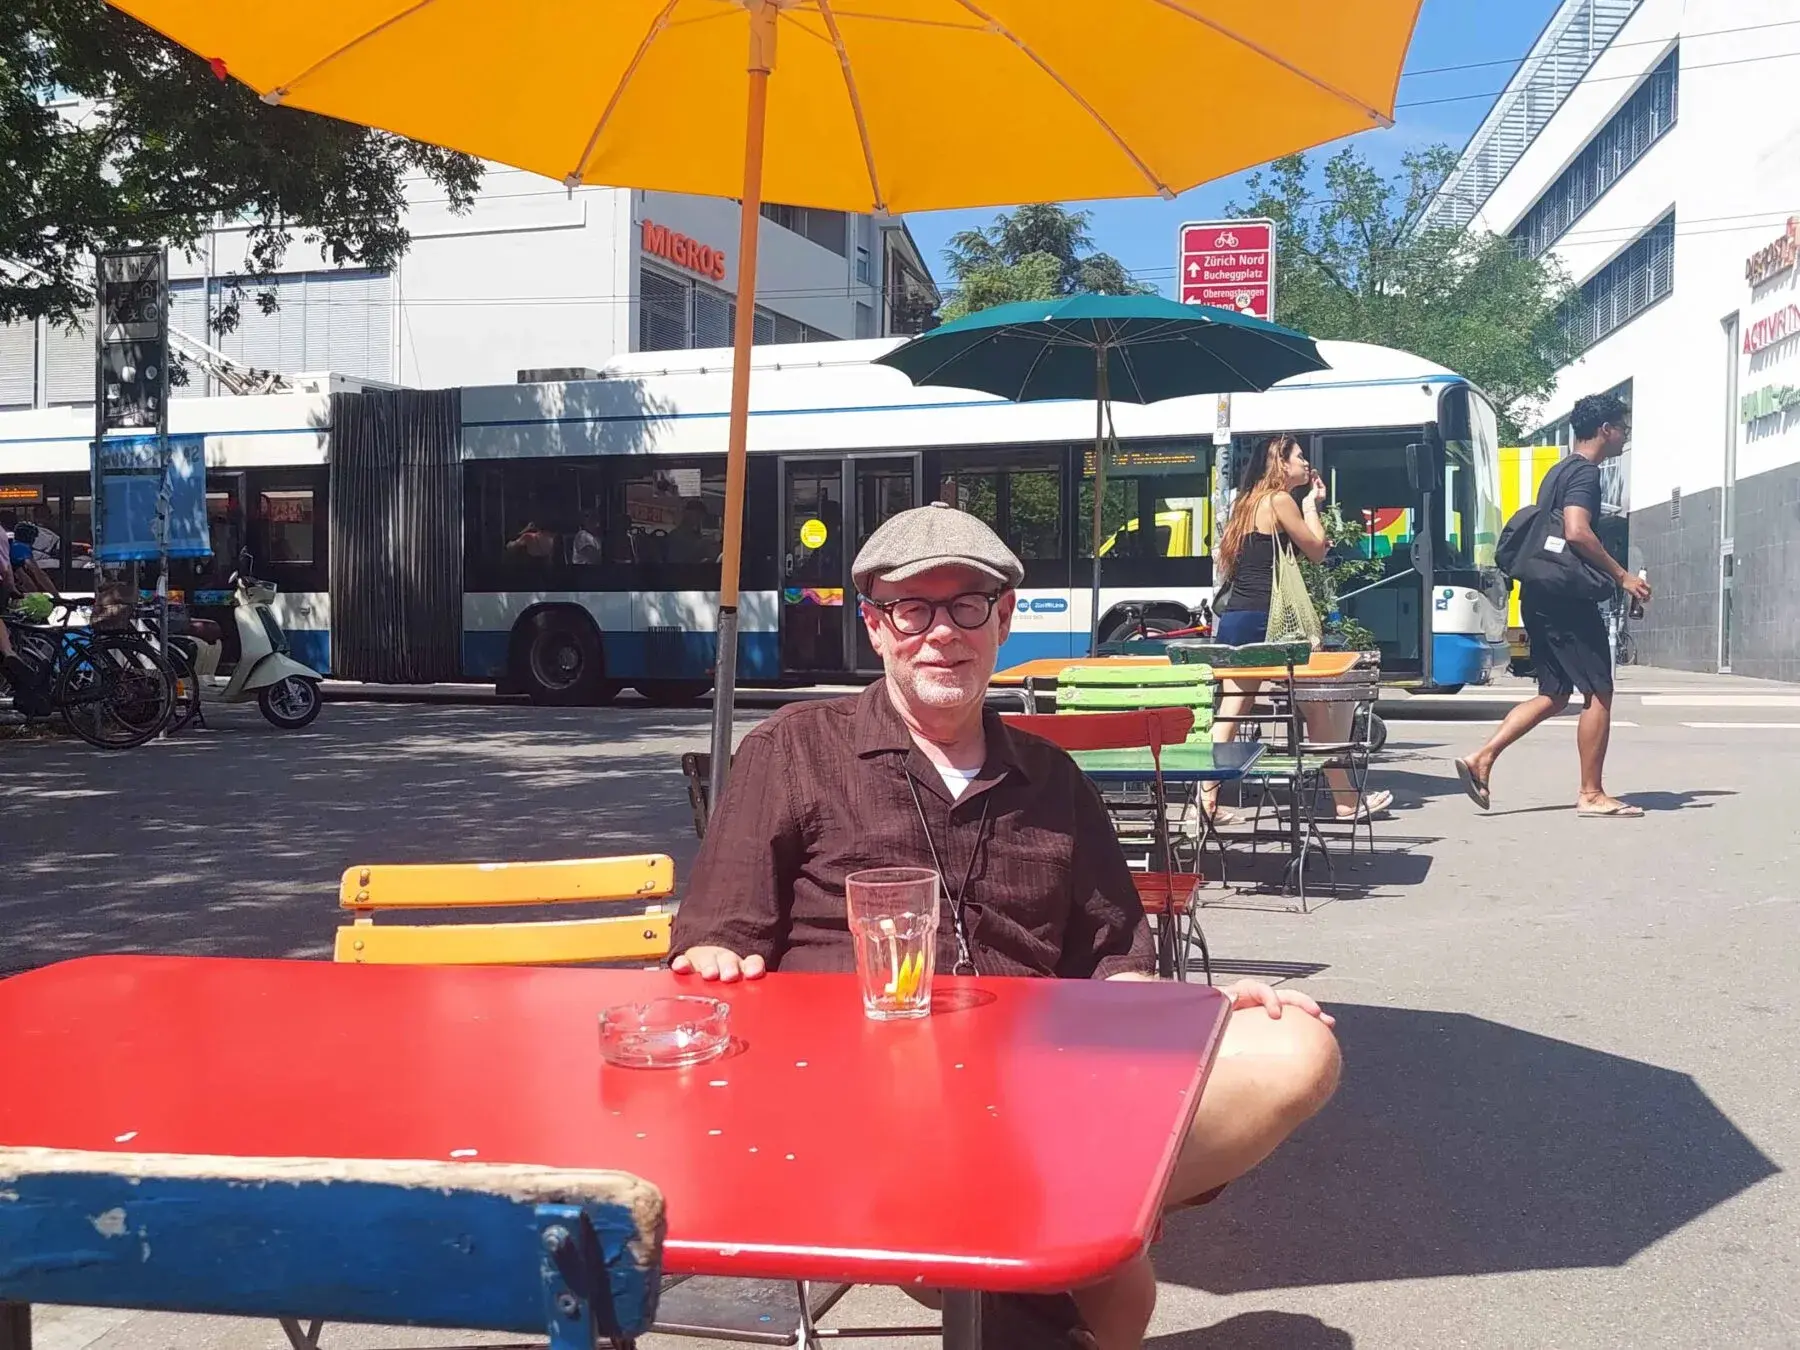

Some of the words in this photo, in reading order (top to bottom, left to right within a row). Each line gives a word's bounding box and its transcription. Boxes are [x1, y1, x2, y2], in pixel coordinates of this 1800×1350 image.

[642, 219, 725, 281] MIGROS
[1204, 255, 1236, 267] Zürich
[1239, 253, 1265, 265] Nord
[117, 262, 146, 275] ZNE
[1203, 269, 1264, 282] Bucheggplatz
